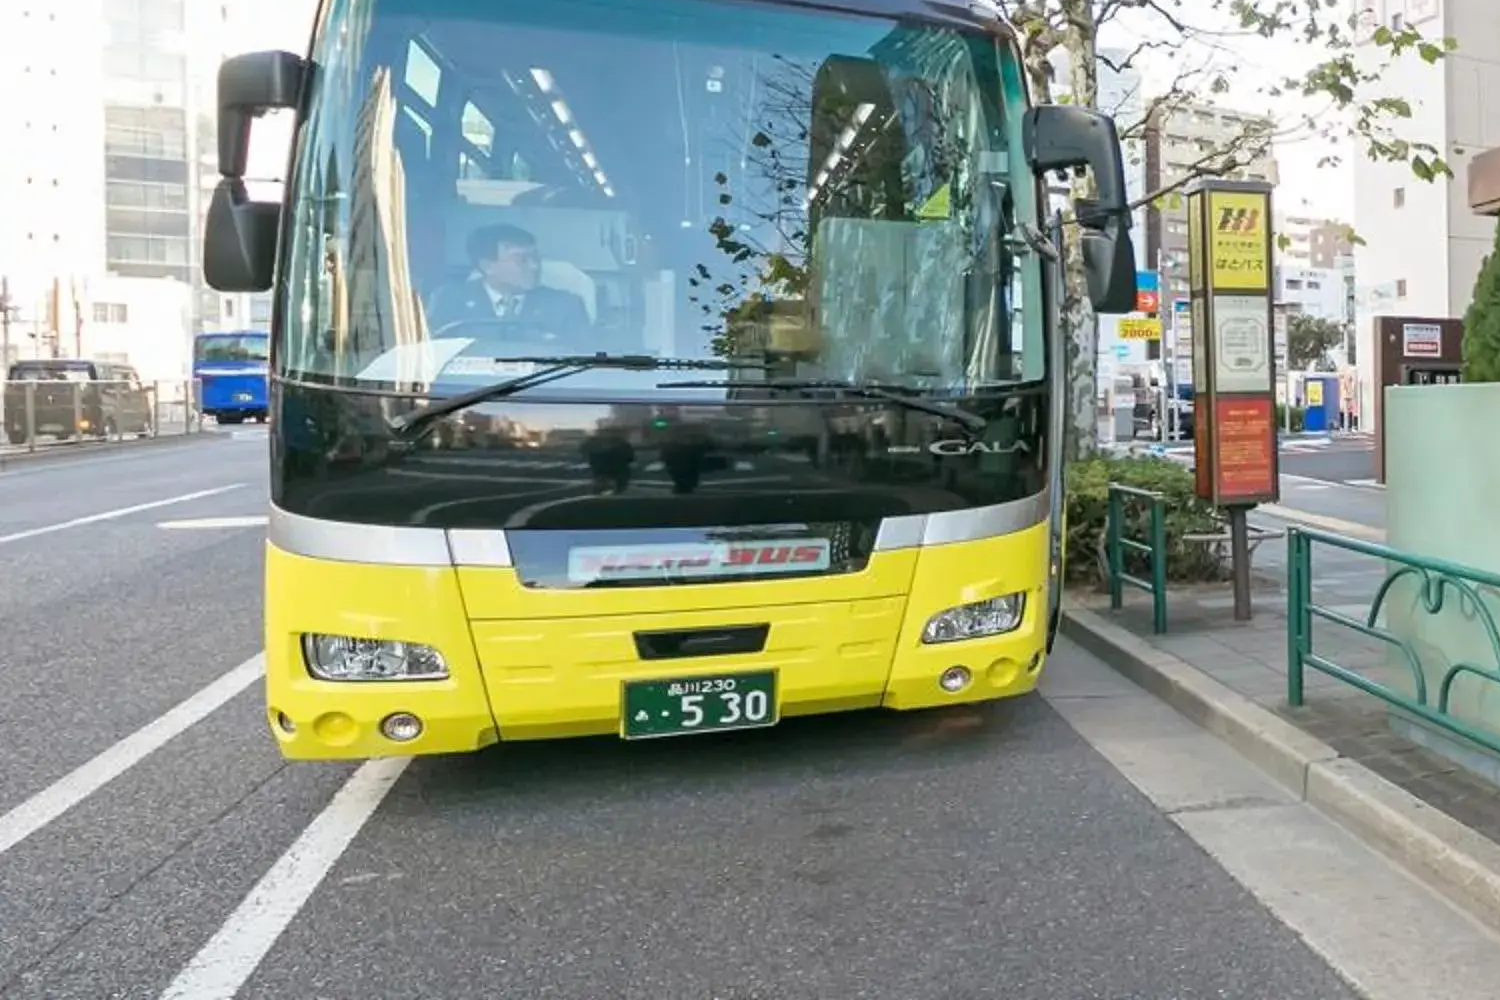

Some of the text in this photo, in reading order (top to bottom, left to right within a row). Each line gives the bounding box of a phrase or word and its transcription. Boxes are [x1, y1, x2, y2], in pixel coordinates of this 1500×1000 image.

[1215, 258, 1263, 271] はとバス
[929, 439, 1030, 455] GALA
